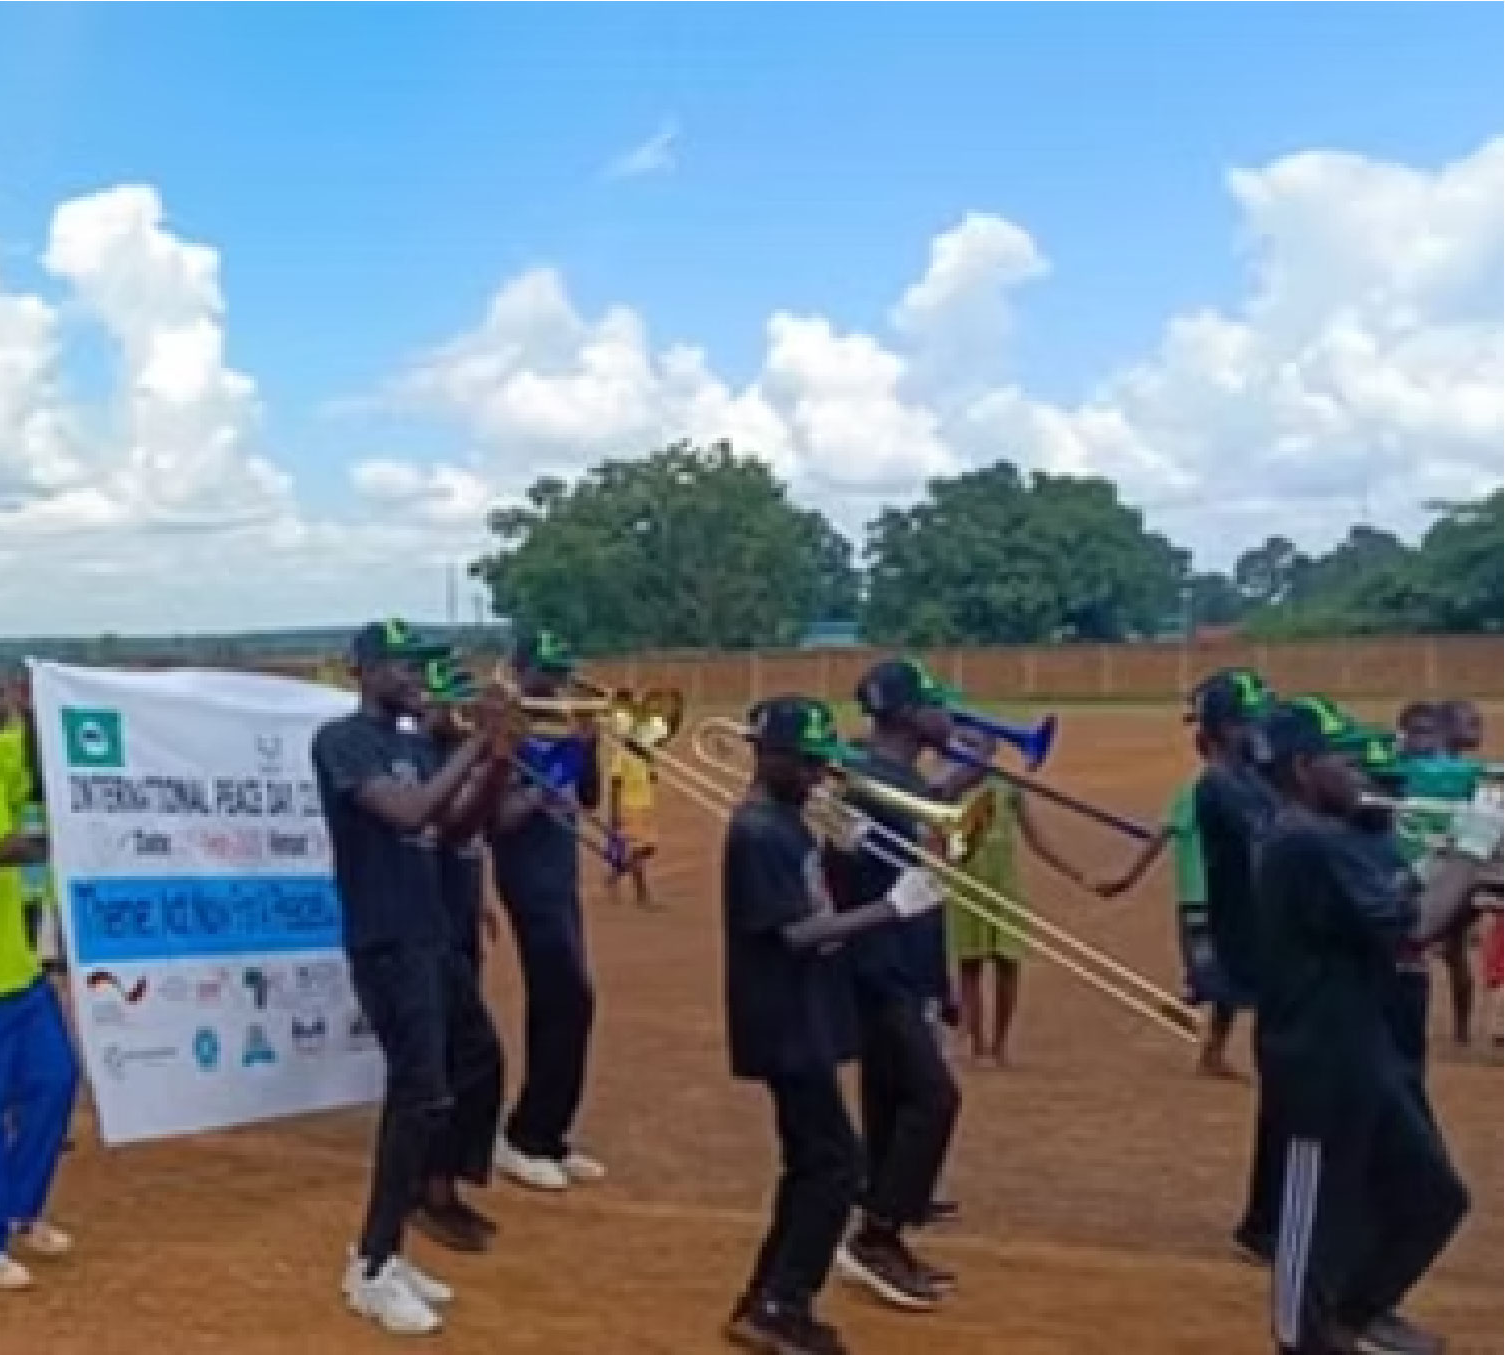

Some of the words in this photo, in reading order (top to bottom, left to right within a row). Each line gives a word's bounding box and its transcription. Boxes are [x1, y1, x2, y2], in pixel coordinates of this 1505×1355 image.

[70, 775, 209, 815] INTERNATIONAL
[216, 779, 263, 818] PEACE
[266, 781, 293, 818] DAY
